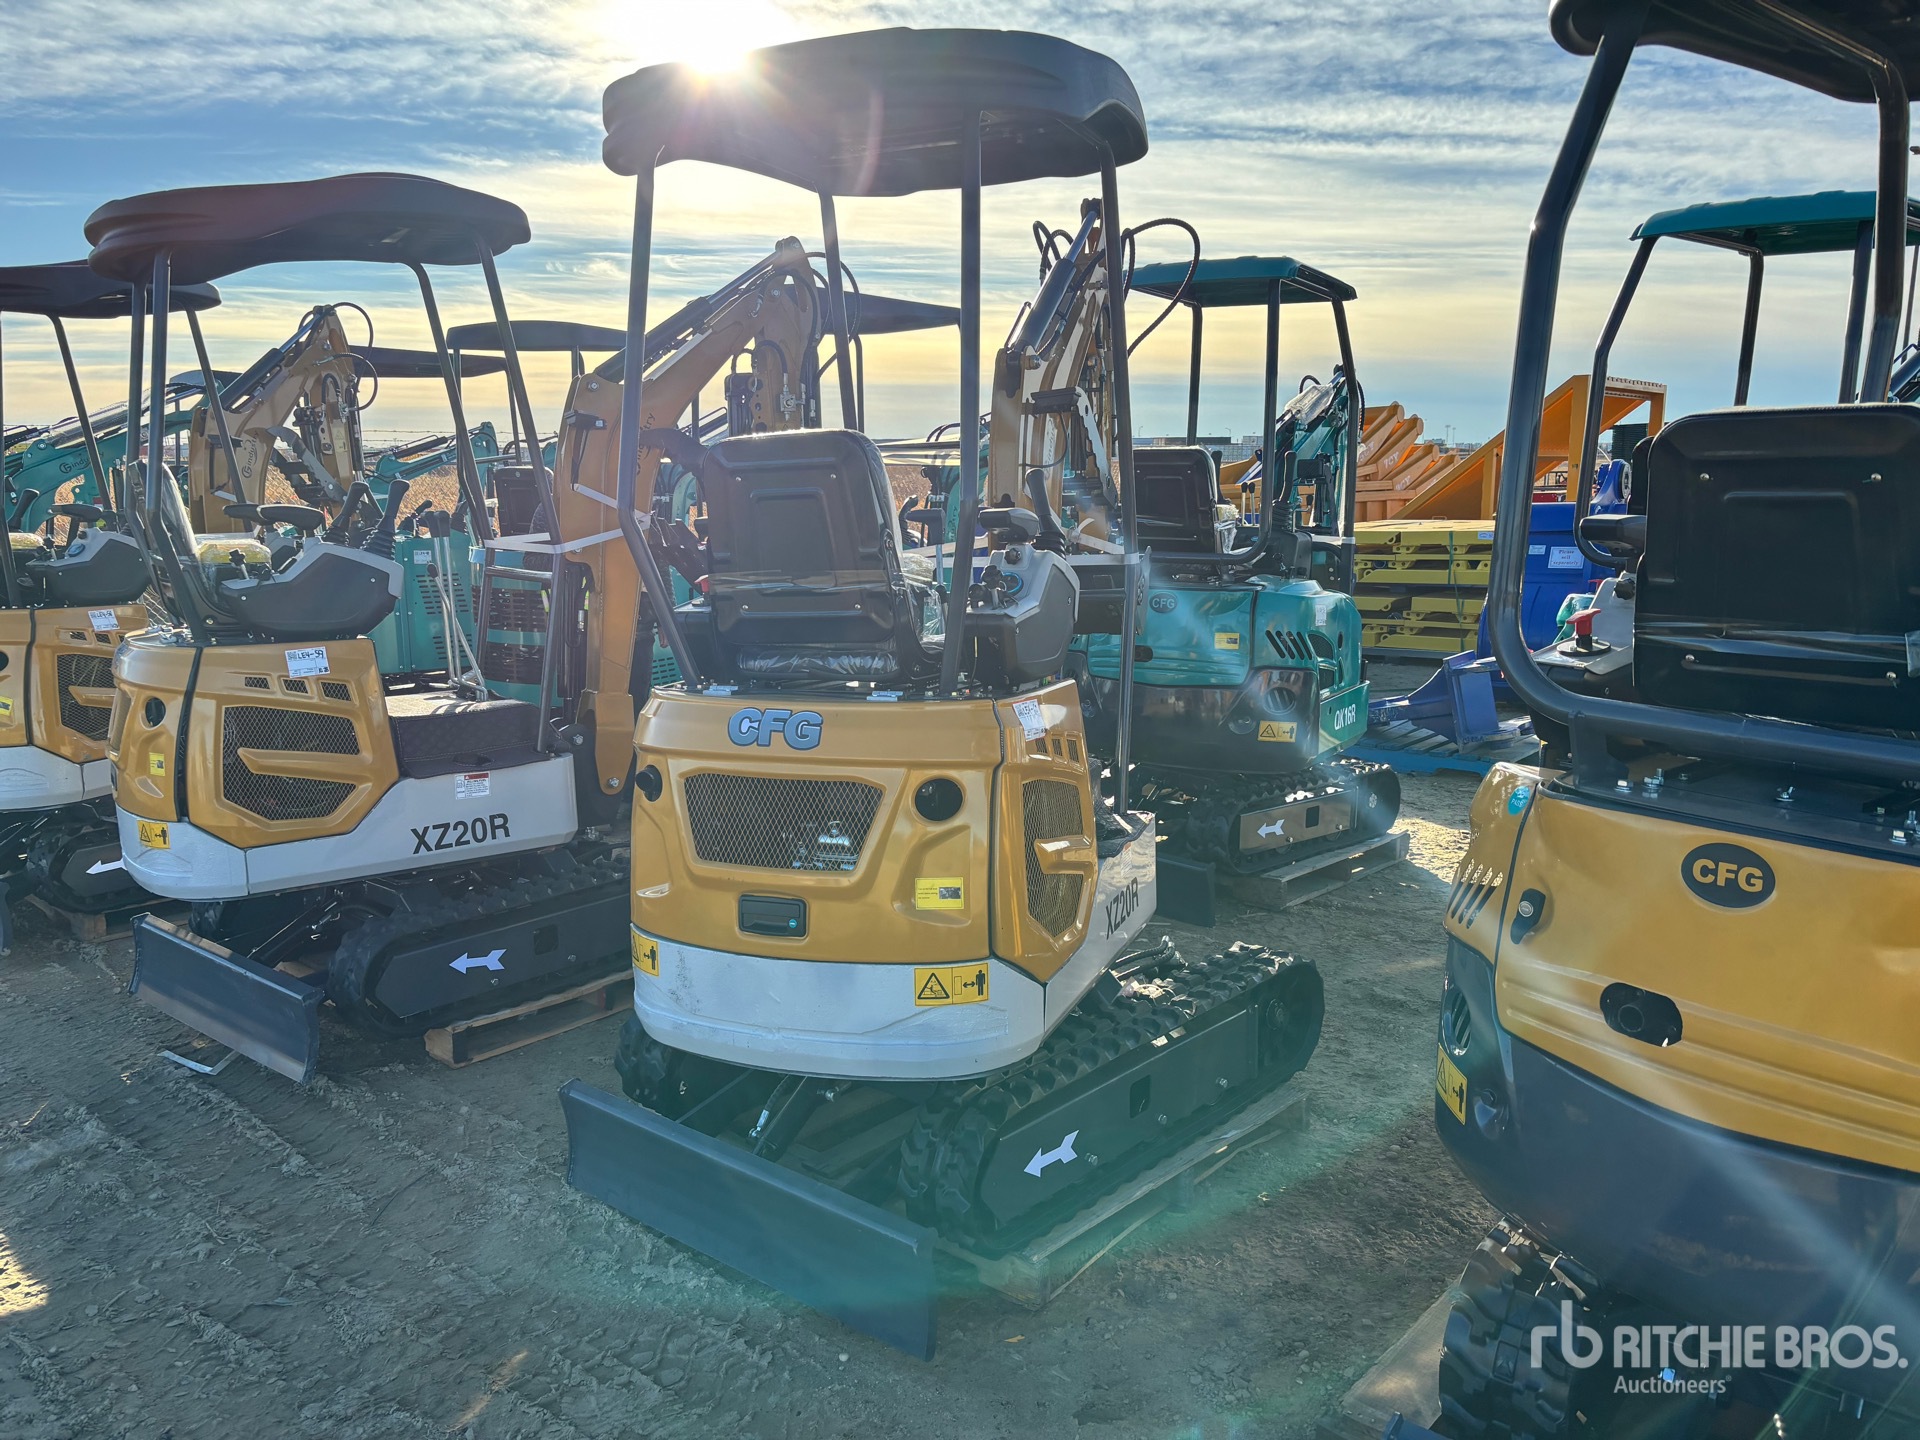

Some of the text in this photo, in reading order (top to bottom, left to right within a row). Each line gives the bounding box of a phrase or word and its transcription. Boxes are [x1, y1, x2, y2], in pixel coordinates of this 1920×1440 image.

[1152, 597, 1175, 609] CFG
[727, 706, 824, 751] CFG
[410, 812, 511, 855] XZ20R
[1692, 858, 1764, 893] CFG
[1105, 876, 1139, 940] XZ20R
